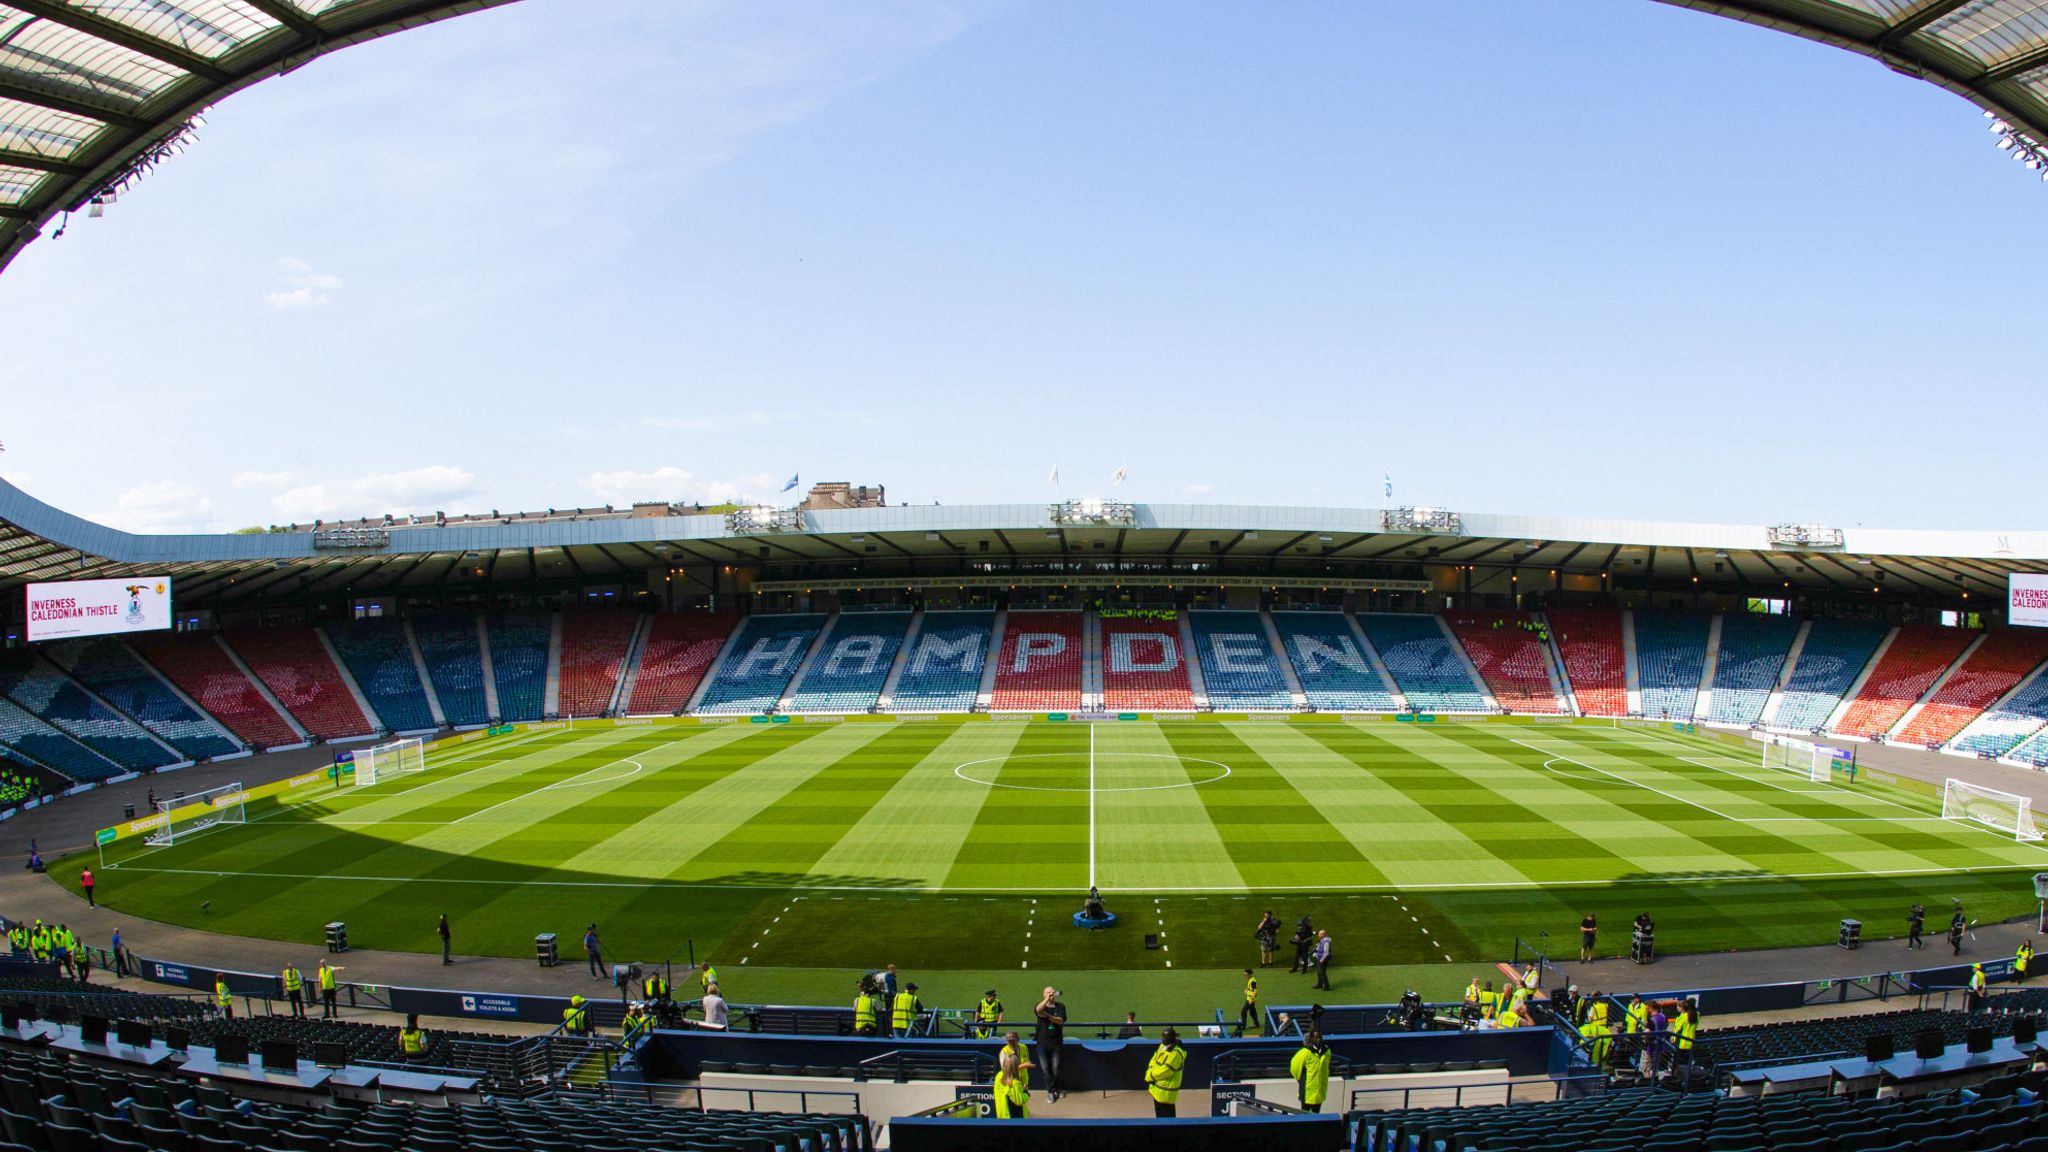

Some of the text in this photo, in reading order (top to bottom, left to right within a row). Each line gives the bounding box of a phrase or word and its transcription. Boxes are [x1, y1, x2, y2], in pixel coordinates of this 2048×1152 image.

[31, 598, 76, 610] INVERNESS
[31, 604, 118, 621] CALEDONIAN THISTLE
[614, 718, 653, 726] Specsavers
[896, 714, 938, 722] Specsavers
[1153, 713, 1195, 722] Specsavers
[1248, 713, 1290, 722] Specsavers
[1341, 714, 1383, 722] Specsavers
